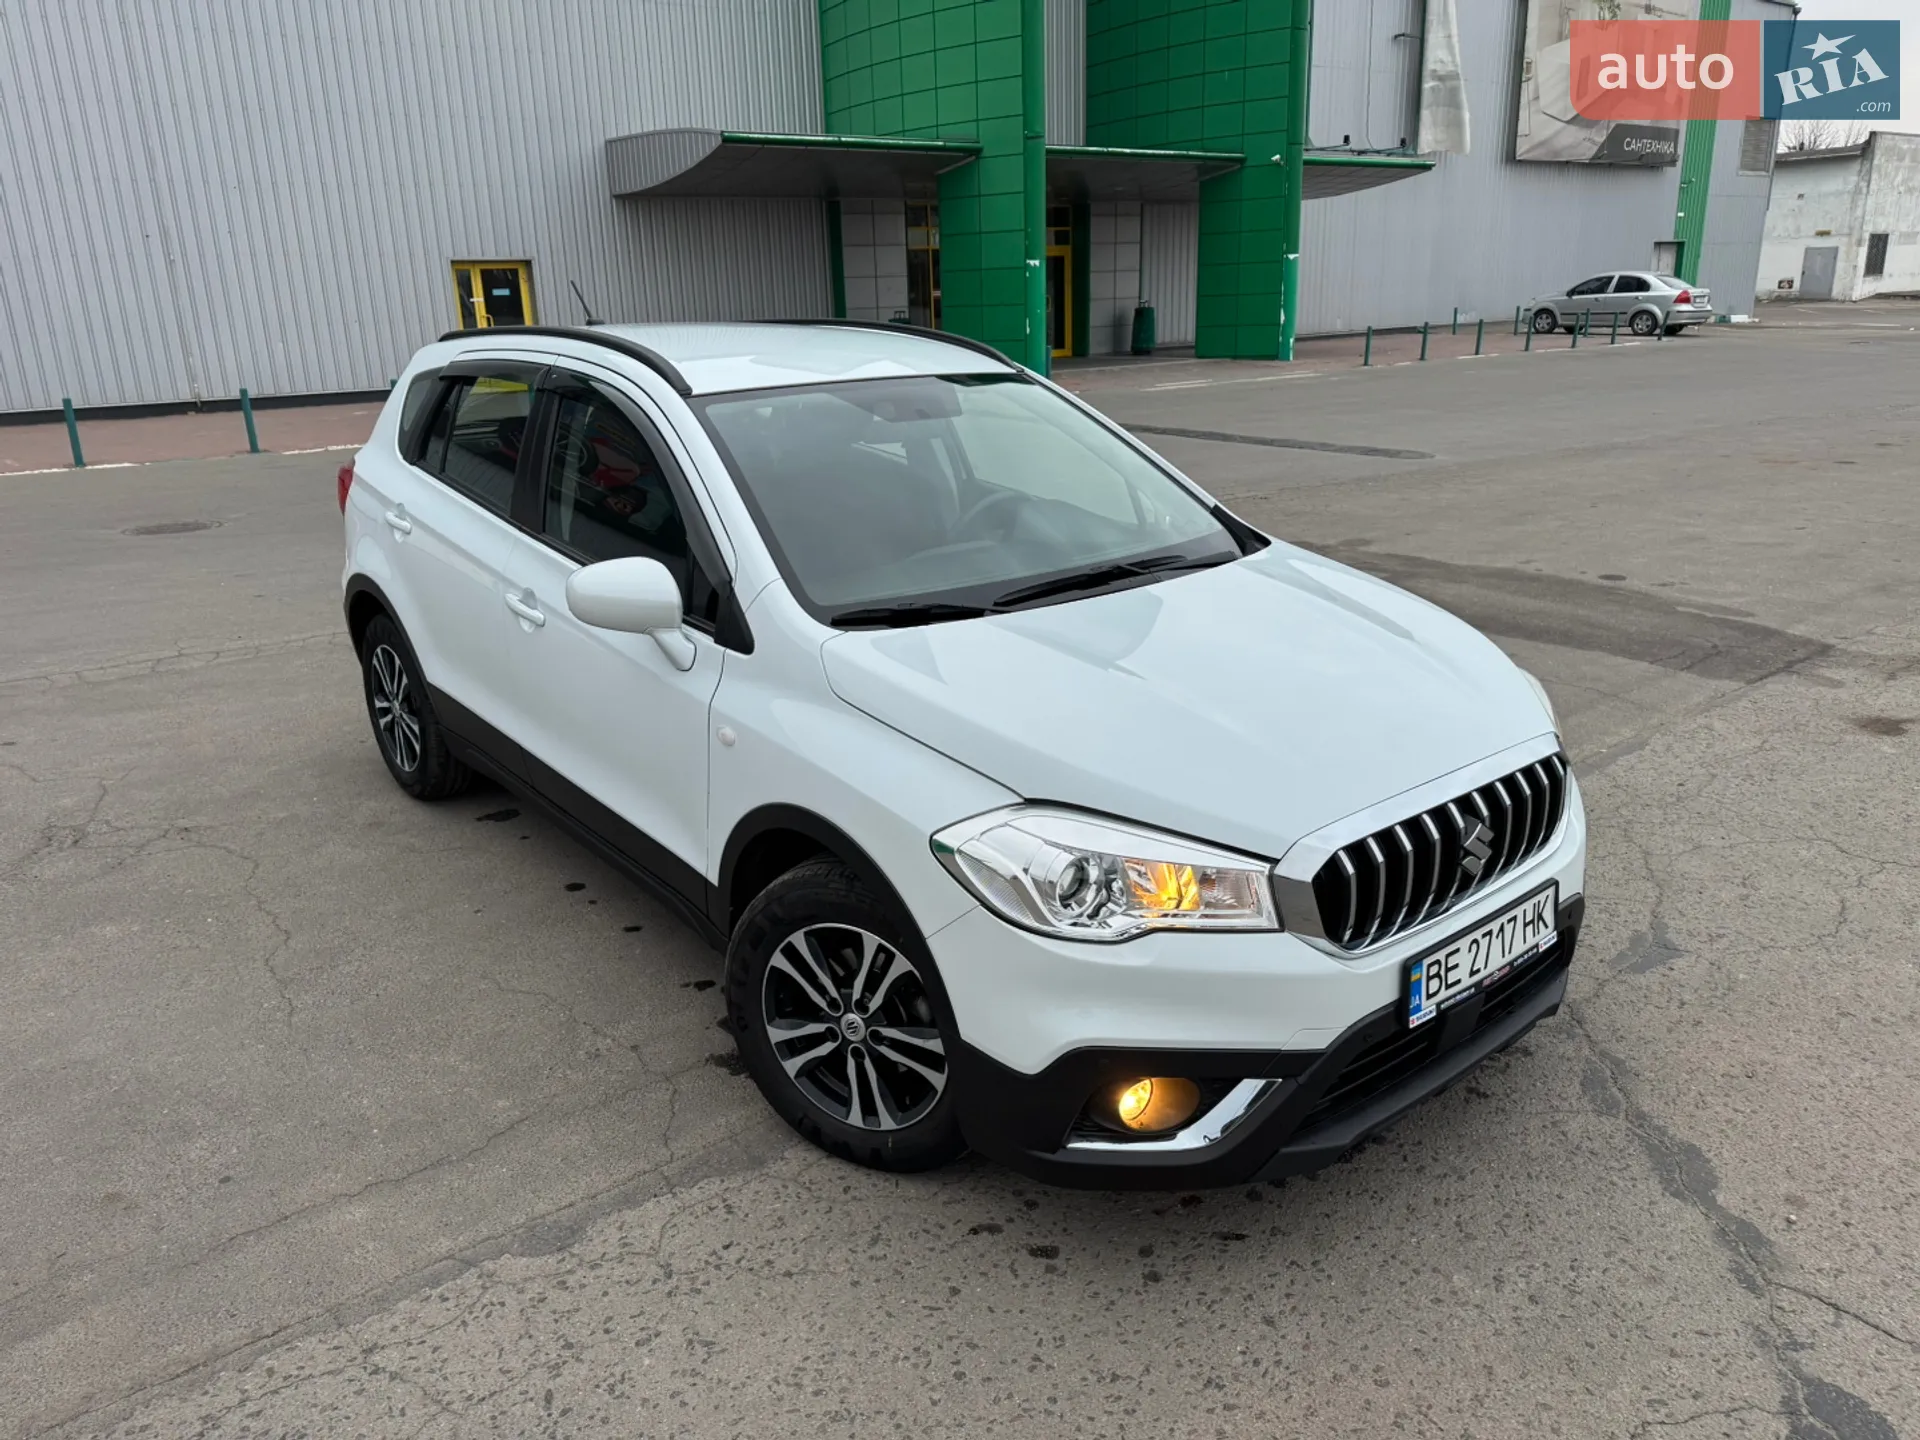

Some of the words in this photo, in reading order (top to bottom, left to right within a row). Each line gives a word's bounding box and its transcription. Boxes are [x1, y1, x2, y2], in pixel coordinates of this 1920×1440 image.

[1425, 947, 1461, 1001] BE
[1467, 914, 1518, 979] 2717
[1522, 894, 1550, 945] HK
